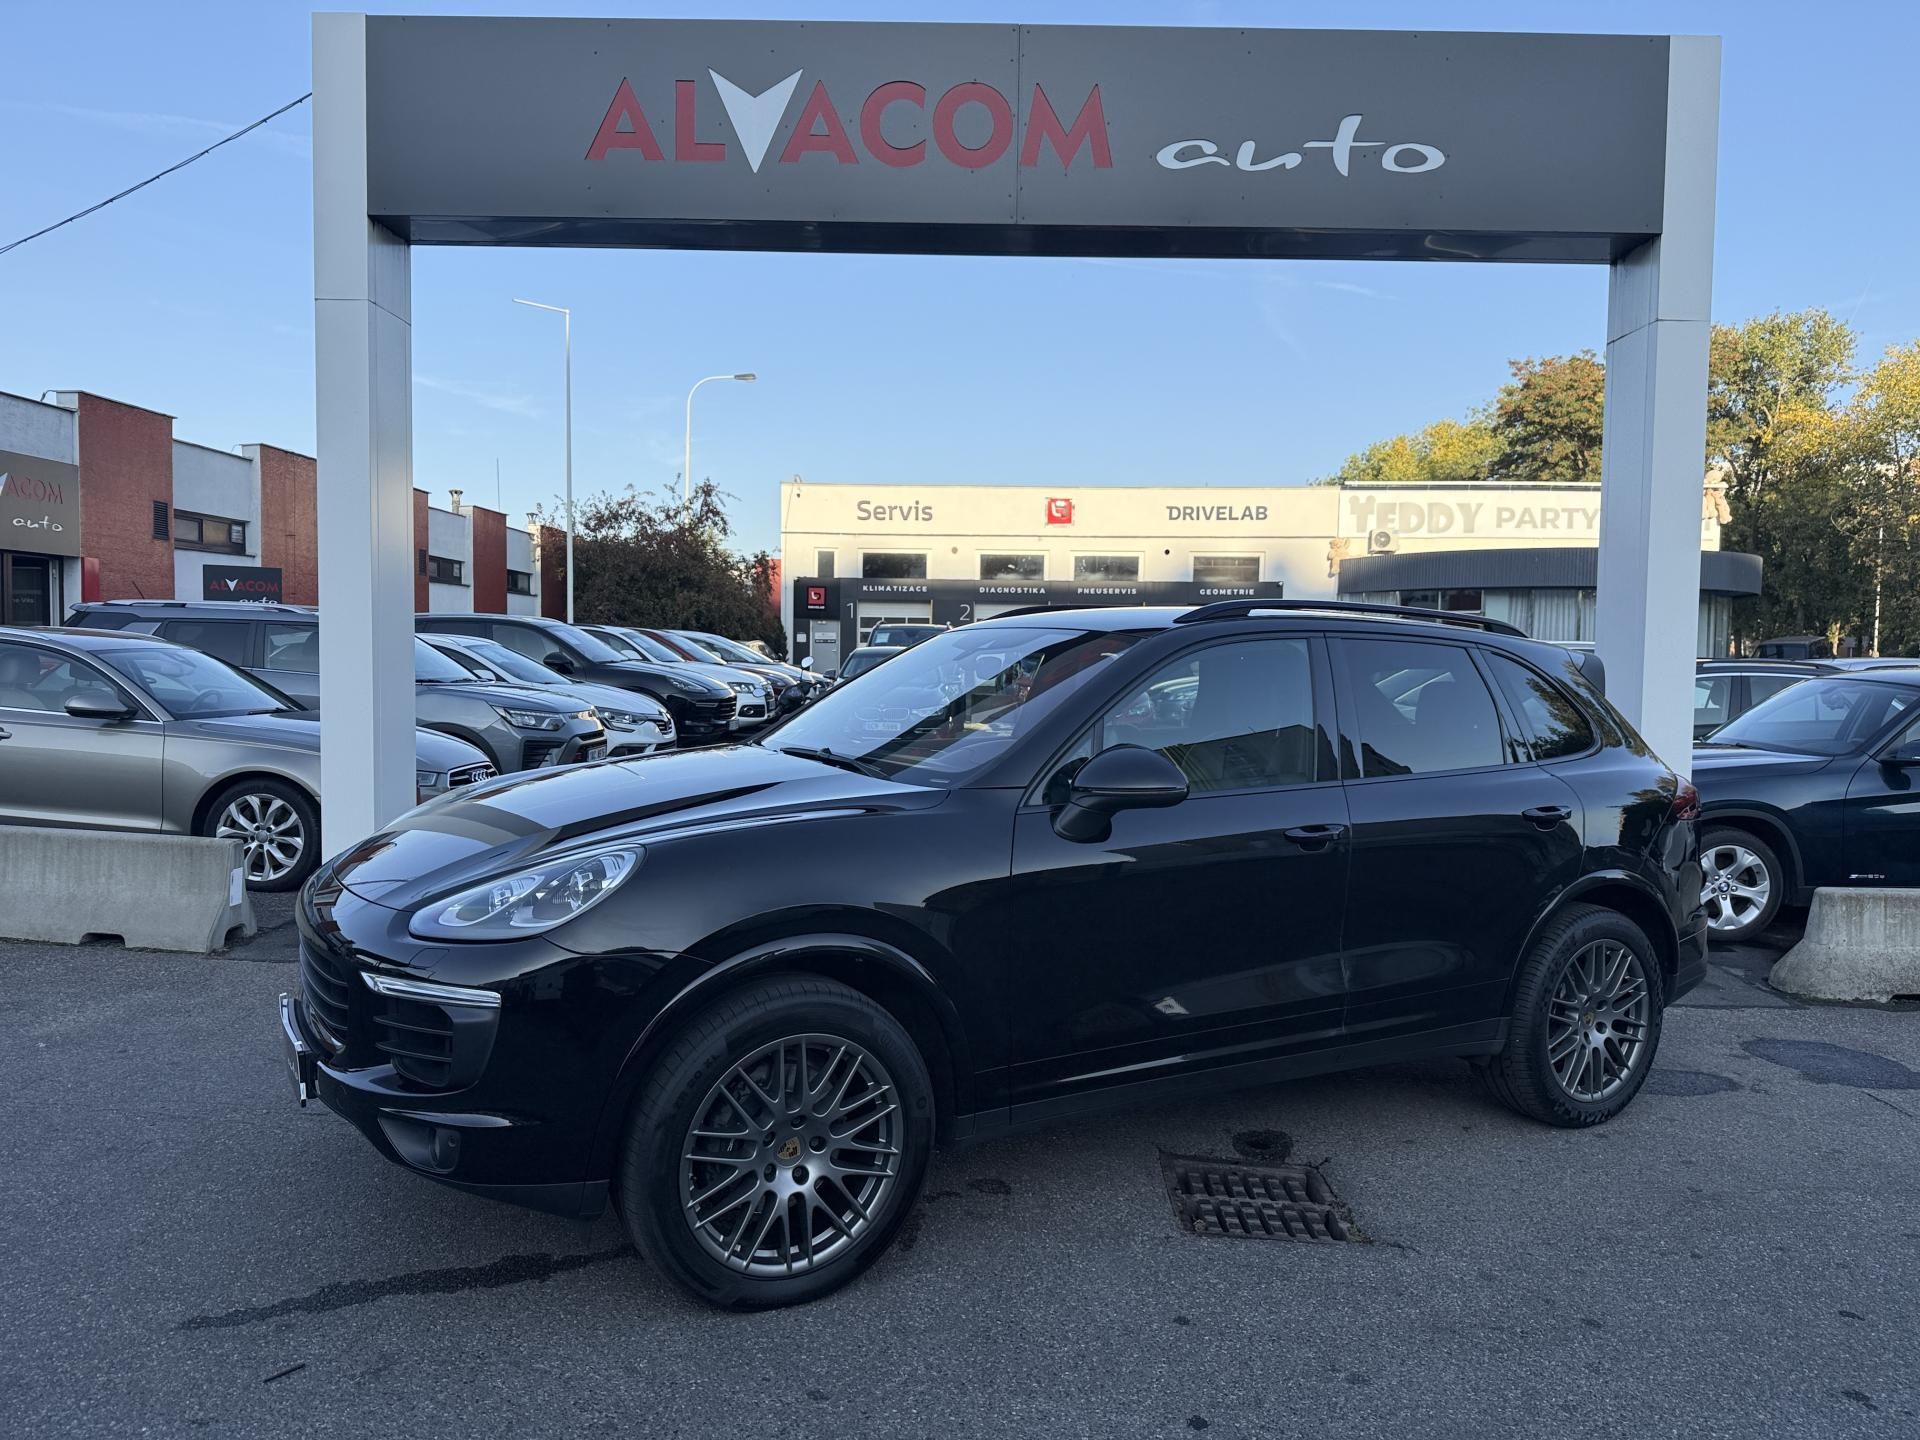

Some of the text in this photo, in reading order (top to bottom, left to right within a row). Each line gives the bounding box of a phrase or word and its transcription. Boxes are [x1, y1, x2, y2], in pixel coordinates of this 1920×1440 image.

[584, 68, 1447, 177] ALVACOM auto
[856, 500, 934, 521] Servis
[1165, 505, 1269, 521] DRIVELAB
[1349, 495, 1600, 534] TEDDY PARTY
[12, 516, 63, 532] auto
[862, 585, 928, 593] KLIMATIZACE
[979, 586, 1046, 594] DIAGNOSTIKA
[1077, 587, 1137, 595] PNEUSERVIS
[1199, 588, 1255, 596] GEOMETRIE
[846, 602, 854, 619] 1
[959, 603, 971, 621] 2
